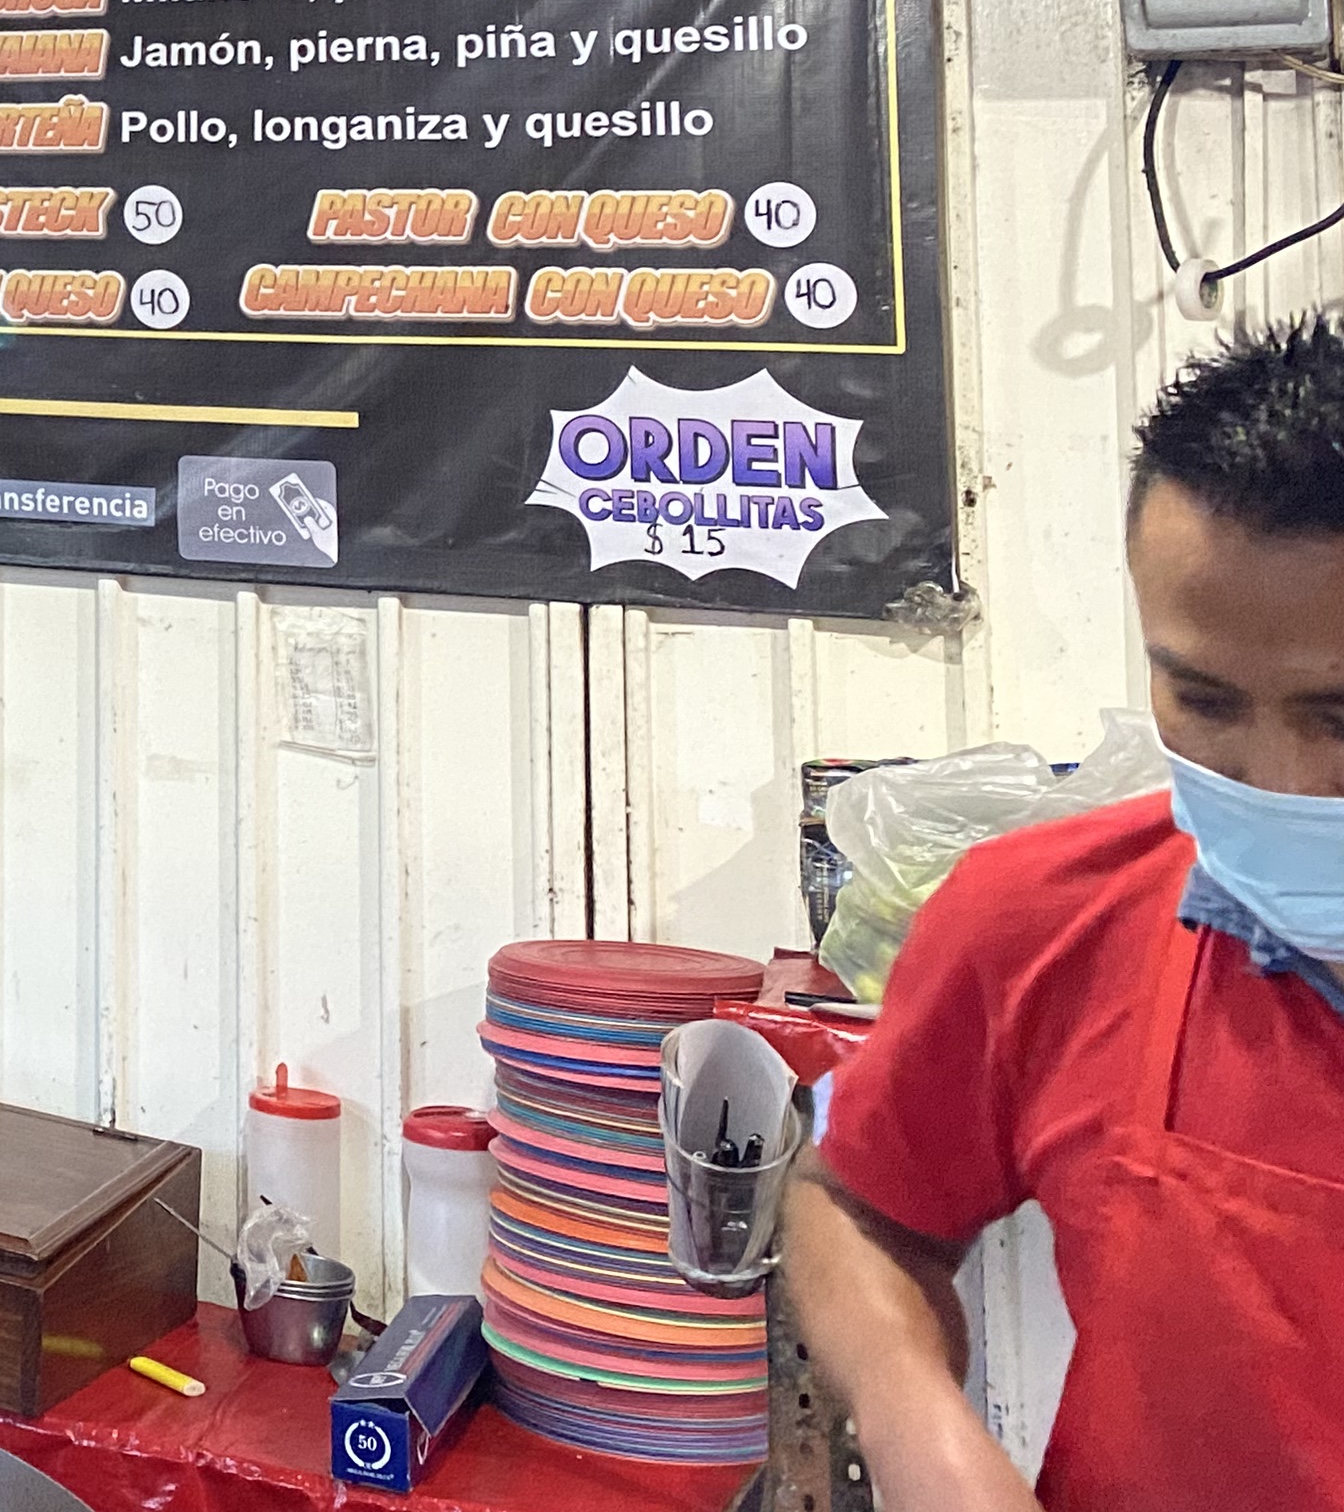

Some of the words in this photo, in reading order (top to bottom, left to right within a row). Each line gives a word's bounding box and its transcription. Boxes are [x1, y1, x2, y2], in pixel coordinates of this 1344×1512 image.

[119, 32, 275, 71] Jamón,
[289, 30, 440, 71] pierna,
[456, 23, 556, 67] piña
[571, 28, 598, 66] y
[615, 15, 808, 66] quesillo
[120, 109, 238, 148] Pollo,
[253, 106, 468, 150] longaniza
[482, 111, 509, 148] y
[525, 100, 714, 148] quesillo
[132, 200, 176, 232] 50
[310, 190, 475, 242] PASTOR
[489, 192, 588, 243] CON
[588, 192, 731, 249] QUESO
[753, 197, 802, 232] 40
[2, 271, 124, 321] QUESO
[139, 287, 179, 316] 40
[242, 265, 514, 318] CAMPECHANA
[528, 267, 626, 320] CON
[628, 269, 772, 325] QUESO
[795, 278, 837, 313] 40
[558, 414, 838, 490] ORDEN
[203, 478, 259, 504] Pago
[218, 505, 246, 521] en
[578, 487, 825, 531] CEBOLLITAS
[199, 522, 287, 548] efectivo
[681, 528, 726, 557] 15
[357, 1434, 377, 1451] 50
